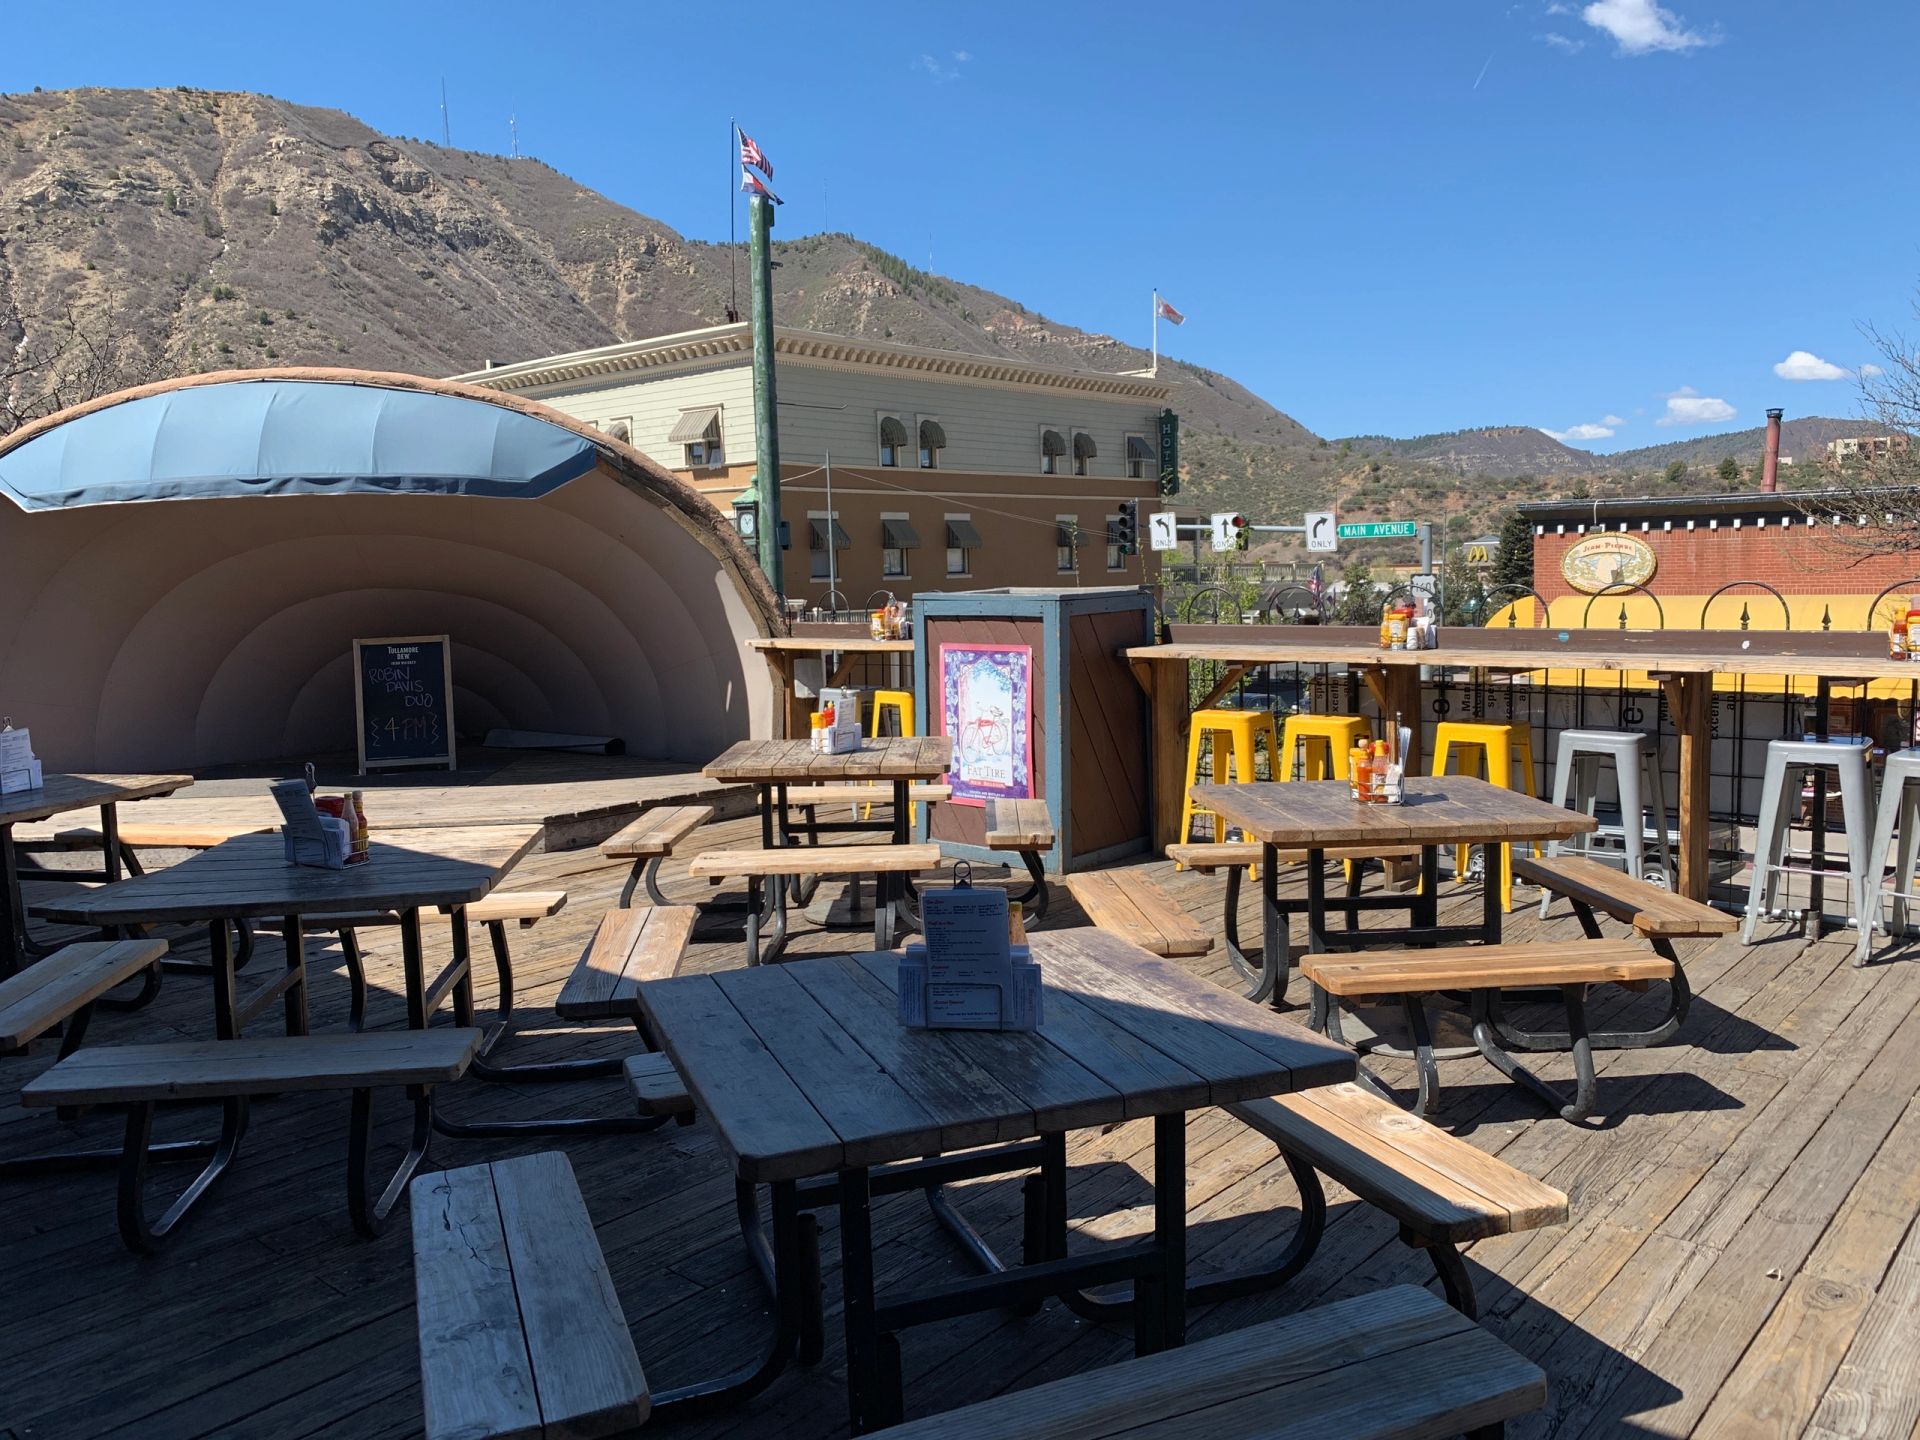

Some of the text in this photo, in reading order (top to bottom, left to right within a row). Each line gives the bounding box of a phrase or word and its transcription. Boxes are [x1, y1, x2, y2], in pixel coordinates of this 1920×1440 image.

[1344, 523, 1410, 536] MAIN AVENUE
[1155, 539, 1174, 547] ONLY
[1311, 540, 1332, 548] ONLY
[368, 666, 410, 685] ROBIN
[385, 679, 425, 693] DAVIS
[404, 692, 434, 708] DUO
[383, 716, 400, 742] 4
[967, 763, 1006, 779] FAT TIRE
